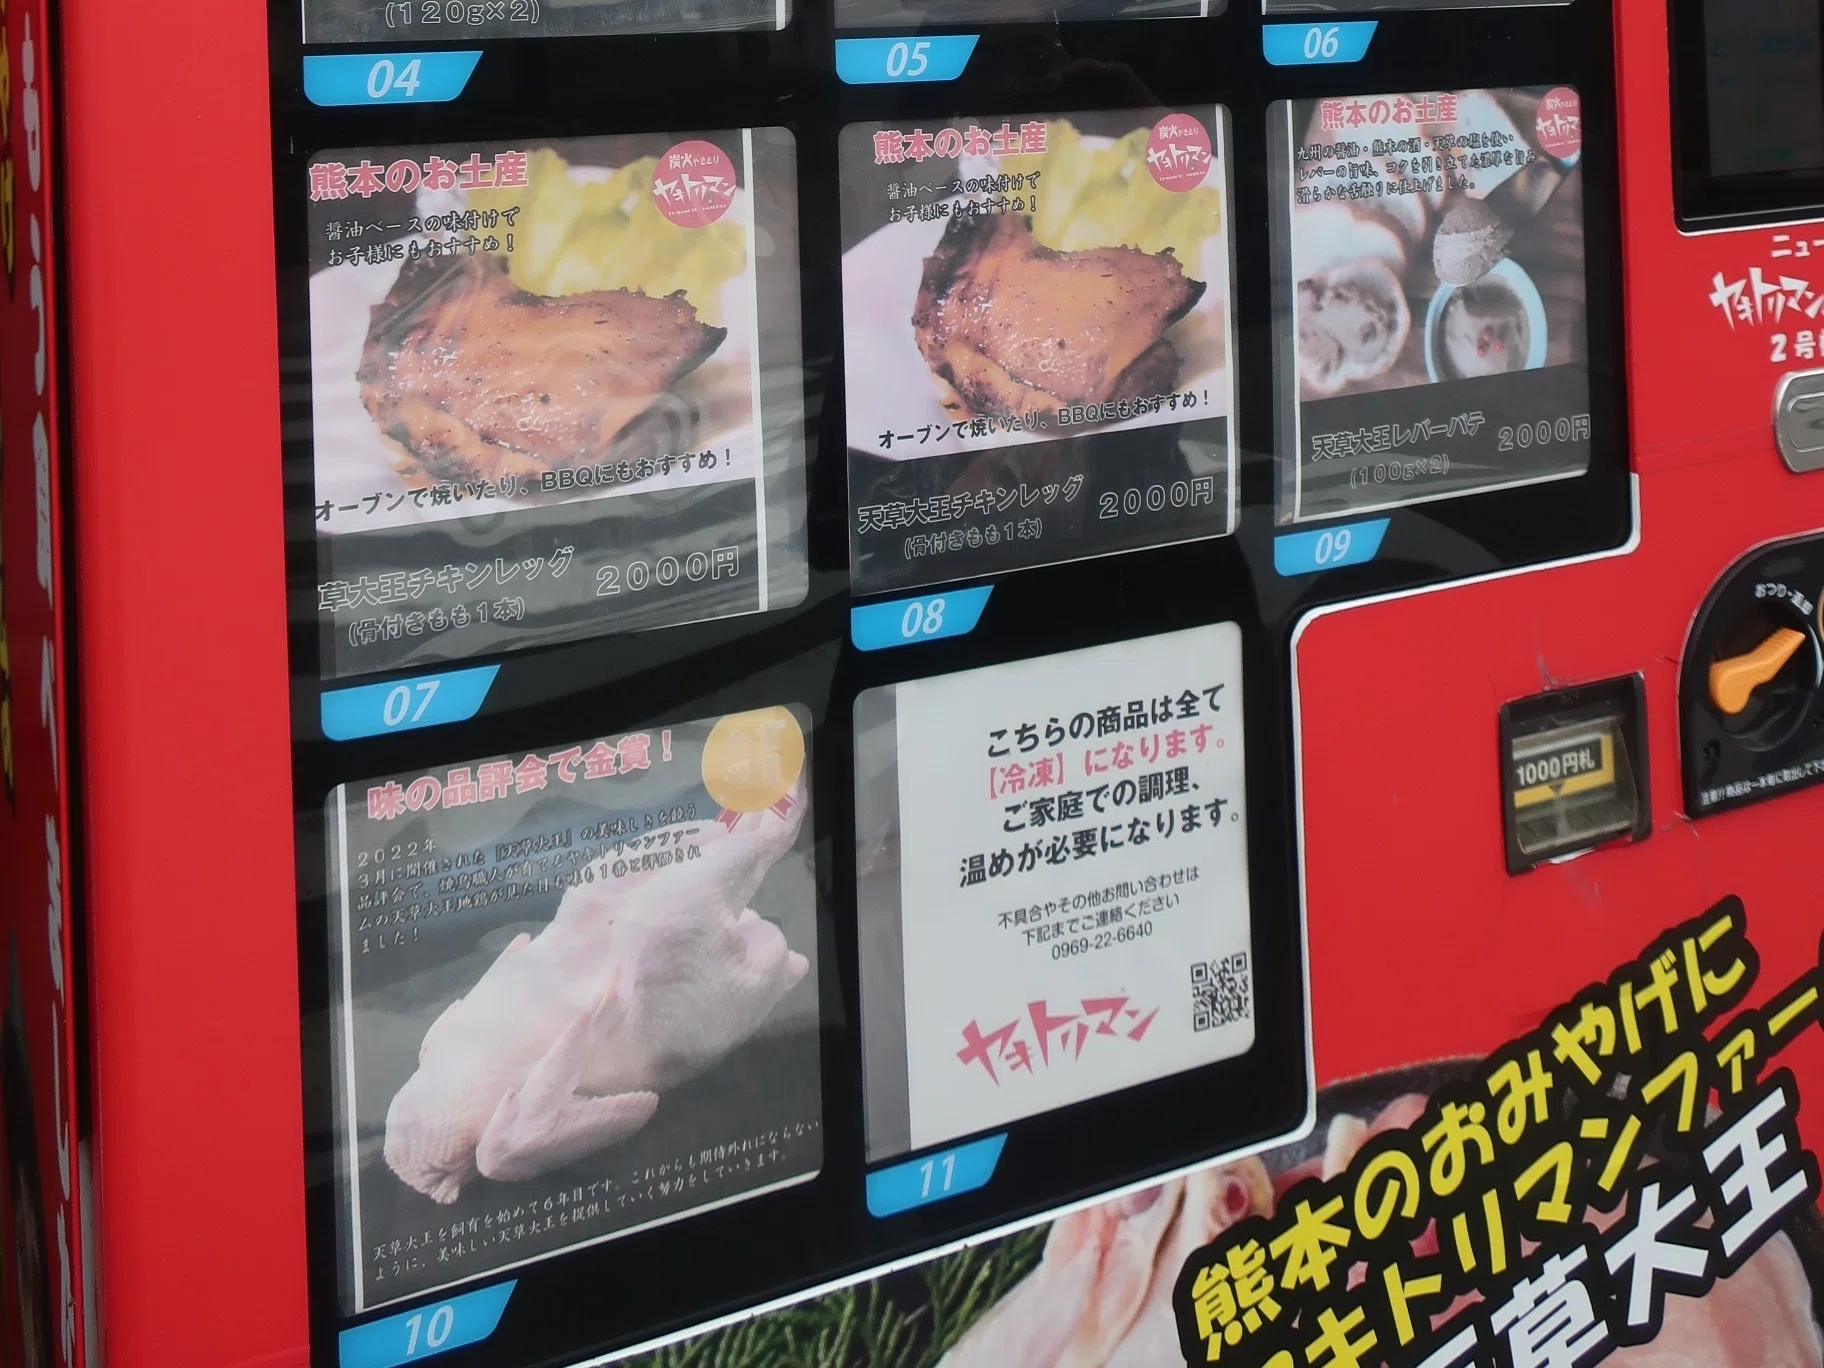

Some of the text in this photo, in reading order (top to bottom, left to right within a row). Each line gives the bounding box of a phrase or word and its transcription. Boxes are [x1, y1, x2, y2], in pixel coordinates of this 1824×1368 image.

[885, 40, 932, 78] 05
[1303, 26, 1341, 59] 06
[365, 58, 422, 99] 04
[1320, 93, 1459, 131] 熊本のお土産
[873, 120, 1049, 166] 熊本のお土産
[1146, 143, 1213, 174] ヤキトリマン
[308, 150, 529, 203] 熊本のお土産
[652, 173, 737, 207] ヤキトリマン
[886, 170, 1042, 201] 醤油ベースの味付けで
[325, 205, 522, 242] 醤油ベースの味付けで
[888, 195, 1038, 224] お子様にもおすすめ！
[327, 233, 516, 268] お子様にもおすすめ！
[1769, 328, 1824, 363] 2号
[878, 389, 1211, 450] オーブンで焼いたり、BBQにもおすすめ！
[1311, 410, 1487, 462] 天草大王レバーパテ
[1498, 413, 1592, 452] 2000円
[314, 446, 733, 523] オーブンで焼いたり、BBQにもおすすめ！
[857, 473, 1085, 535] 天草大王チキンレッグ
[1098, 476, 1215, 521] 2000円
[904, 517, 1044, 560] (骨付きもも1本)
[1314, 528, 1352, 566] 09
[318, 545, 576, 612] 草大王チキンレッグ
[596, 545, 741, 597] 2000円
[348, 596, 525, 648] (骨付きもも1本)
[901, 598, 946, 639] 08
[382, 680, 441, 728] 07
[986, 682, 1227, 758] こちらの商品は全て
[367, 729, 674, 822] 味の品評会で金賞！
[987, 723, 1226, 800] 【冷凍】になります。
[1516, 747, 1596, 787] 1000円札
[1003, 765, 1201, 833] ご家庭での調理、
[356, 836, 437, 870] 2022年
[958, 797, 1241, 888] 温めが必要になります。
[997, 865, 1200, 931] 不具合やその他お問い合わせは
[1021, 891, 1181, 947] 下記までご連絡ください
[1051, 920, 1154, 961] 0969-22-6640
[955, 995, 1162, 1088] ヤキトリマン
[1191, 914, 1748, 1362] 熊本のおみやげに
[920, 1153, 956, 1199] 11
[1258, 986, 1820, 1368] キトリマンファー
[1405, 1086, 1810, 1368] 草大王
[405, 1304, 455, 1357] 10
